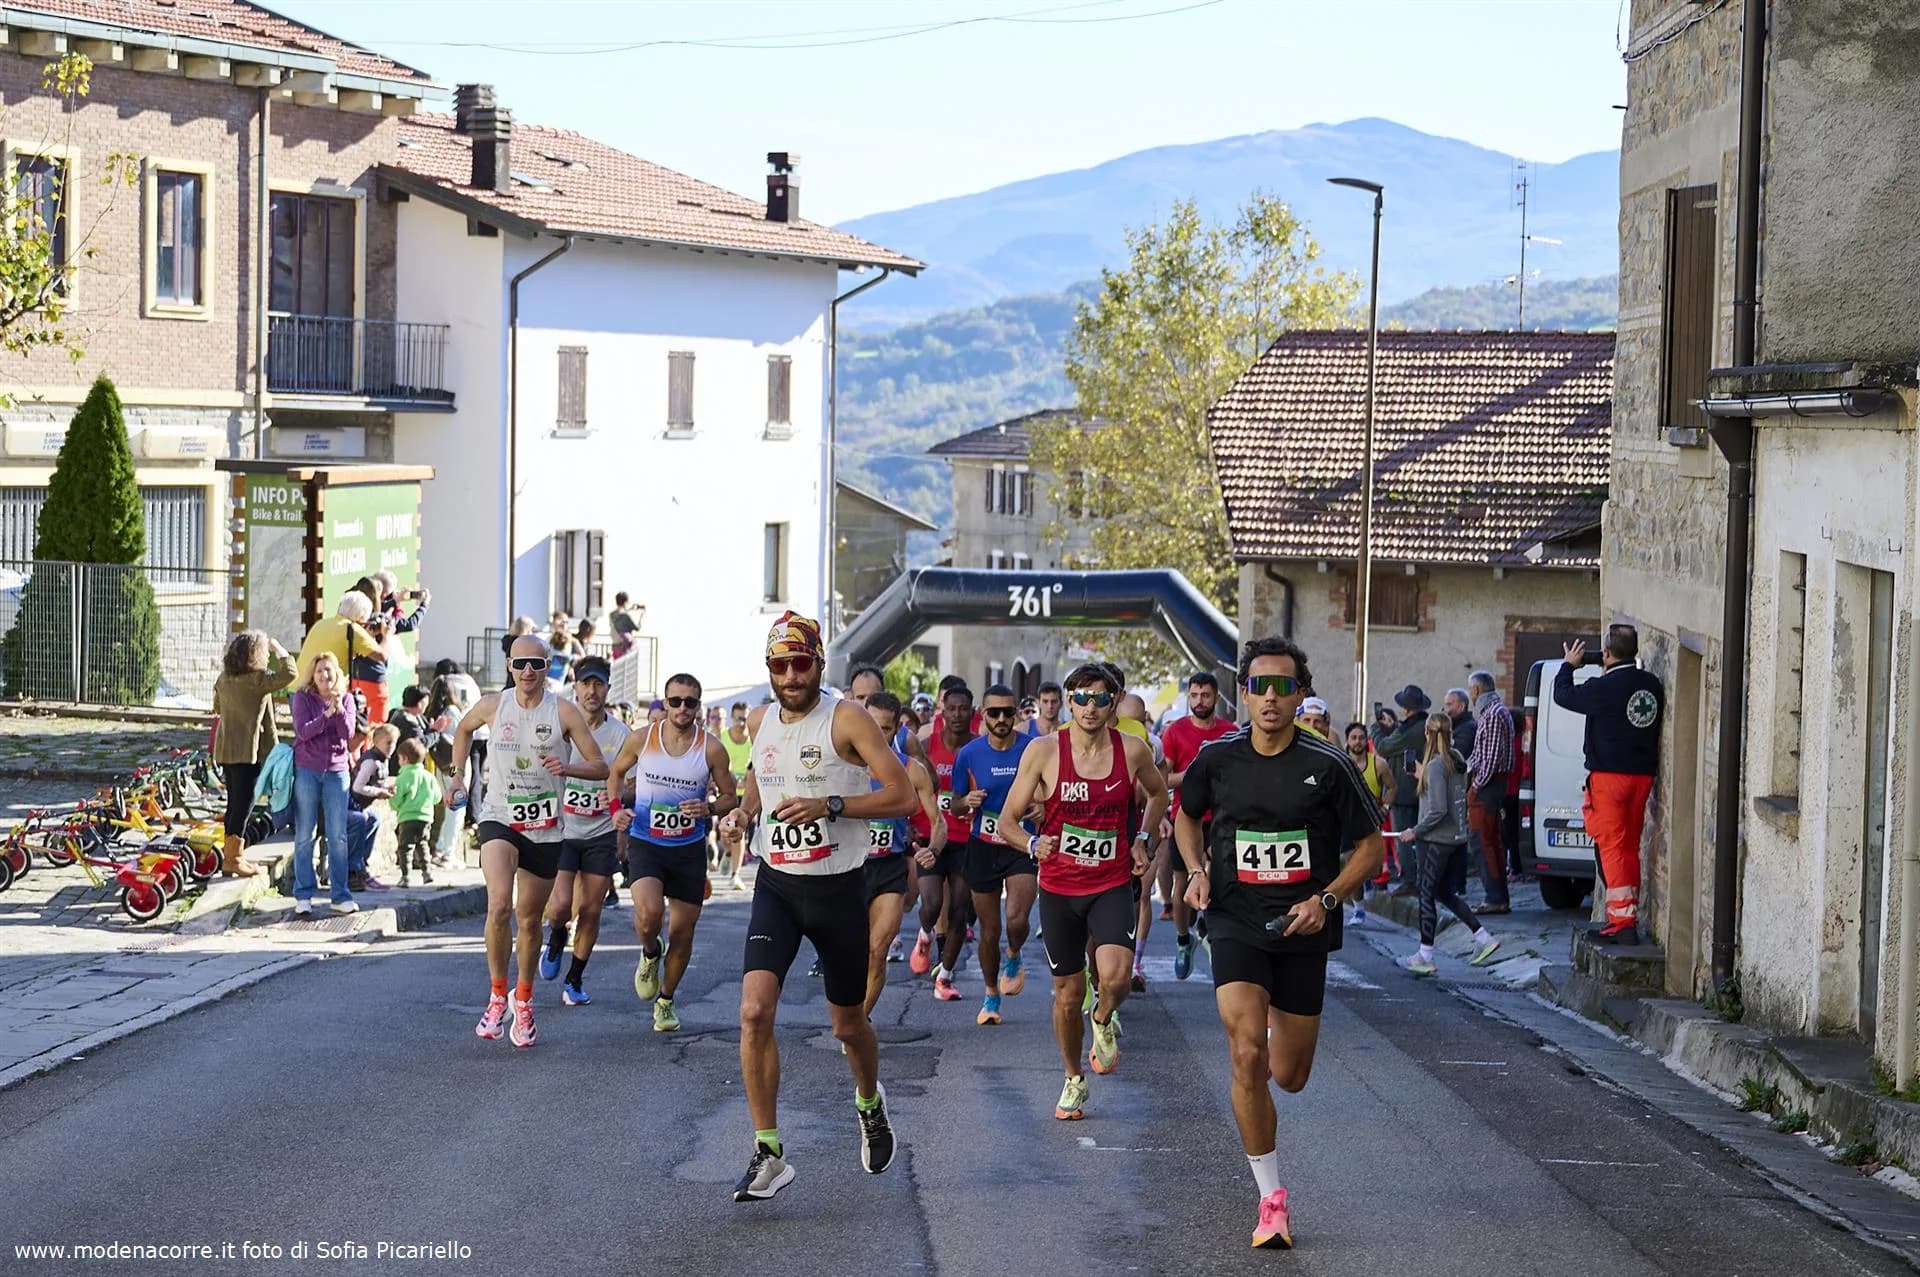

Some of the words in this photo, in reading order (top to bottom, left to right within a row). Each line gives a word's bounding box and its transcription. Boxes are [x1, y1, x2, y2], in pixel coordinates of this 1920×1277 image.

[252, 486, 288, 504] INFO
[252, 508, 272, 521] Bike
[274, 509, 281, 521] &
[1008, 583, 1063, 617] 361°
[661, 776, 698, 787] ATLETICA
[1061, 782, 1089, 801] DKR
[512, 800, 553, 822] 391
[653, 812, 692, 829] 206
[984, 818, 1000, 834] 3
[771, 820, 823, 850] 403
[1556, 832, 1570, 845] FE
[1064, 835, 1112, 859] 240
[1242, 842, 1304, 869] 412
